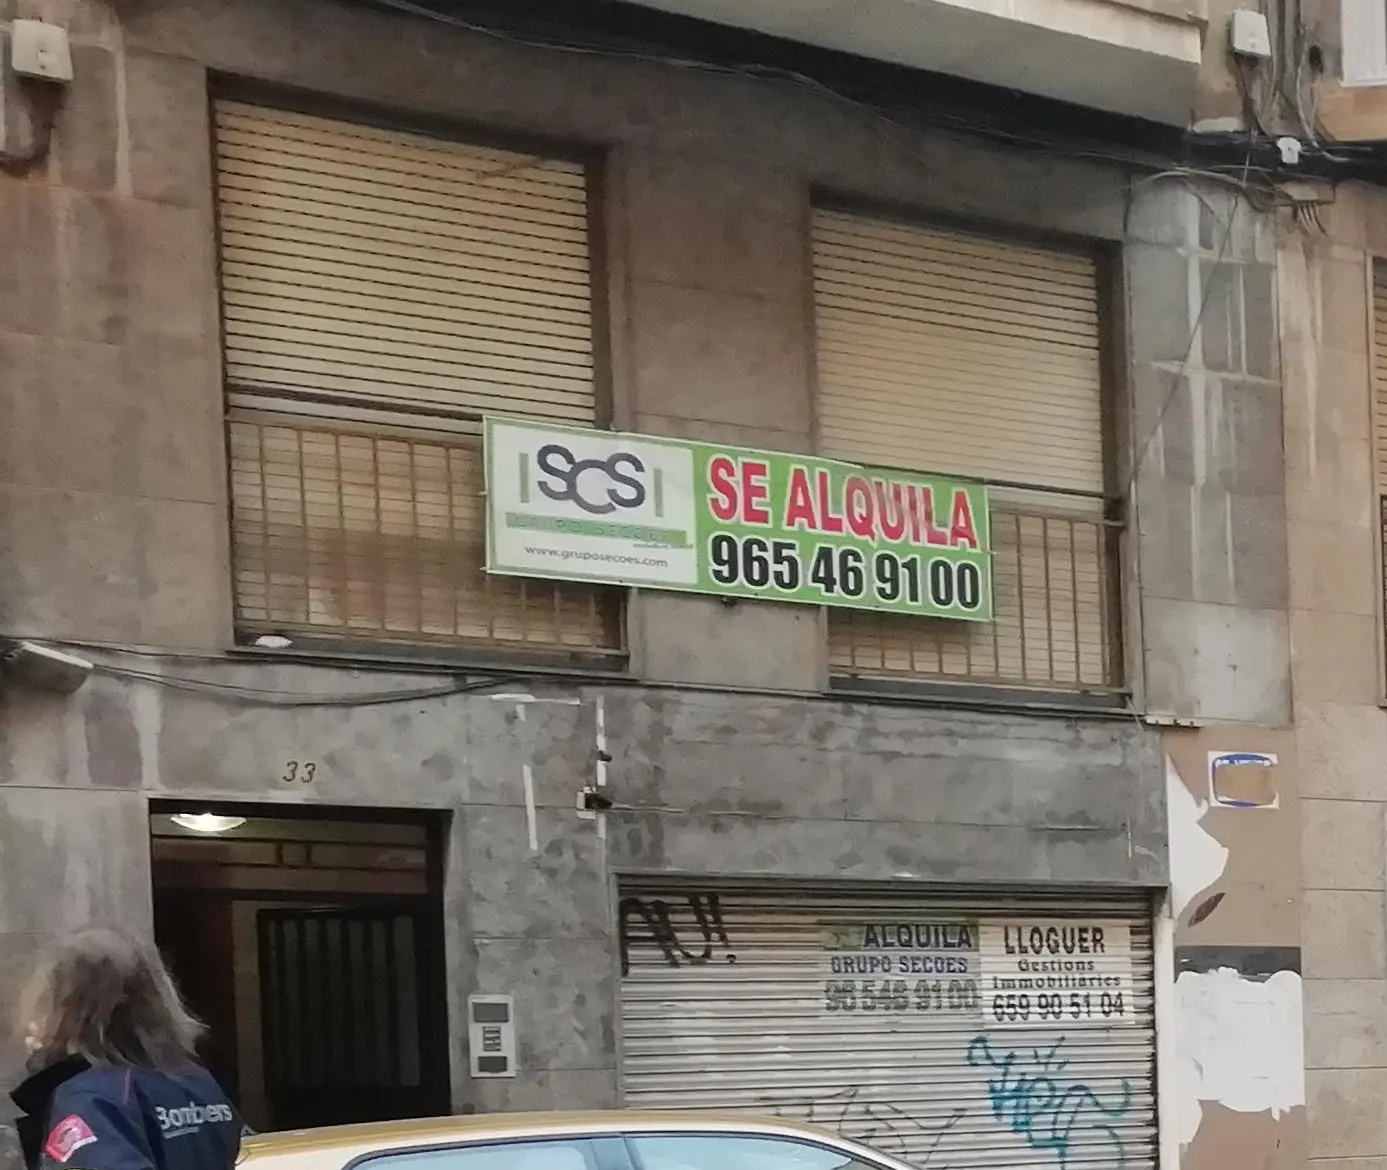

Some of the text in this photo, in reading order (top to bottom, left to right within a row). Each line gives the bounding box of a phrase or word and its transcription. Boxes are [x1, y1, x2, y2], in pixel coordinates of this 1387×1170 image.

[537, 444, 645, 514] SCS
[709, 456, 978, 549] SE ALQUILA
[525, 545, 668, 568] www.gruposecoes.com
[711, 534, 799, 591] 965
[811, 546, 864, 597] 46
[282, 761, 316, 783] 33
[863, 924, 972, 949] ALQUILA
[1004, 925, 1106, 954] LLOGUER
[831, 956, 969, 974] GRUPO SECOES
[1017, 959, 1095, 972] Gestions
[993, 992, 1124, 1021] 659 90 51 04
